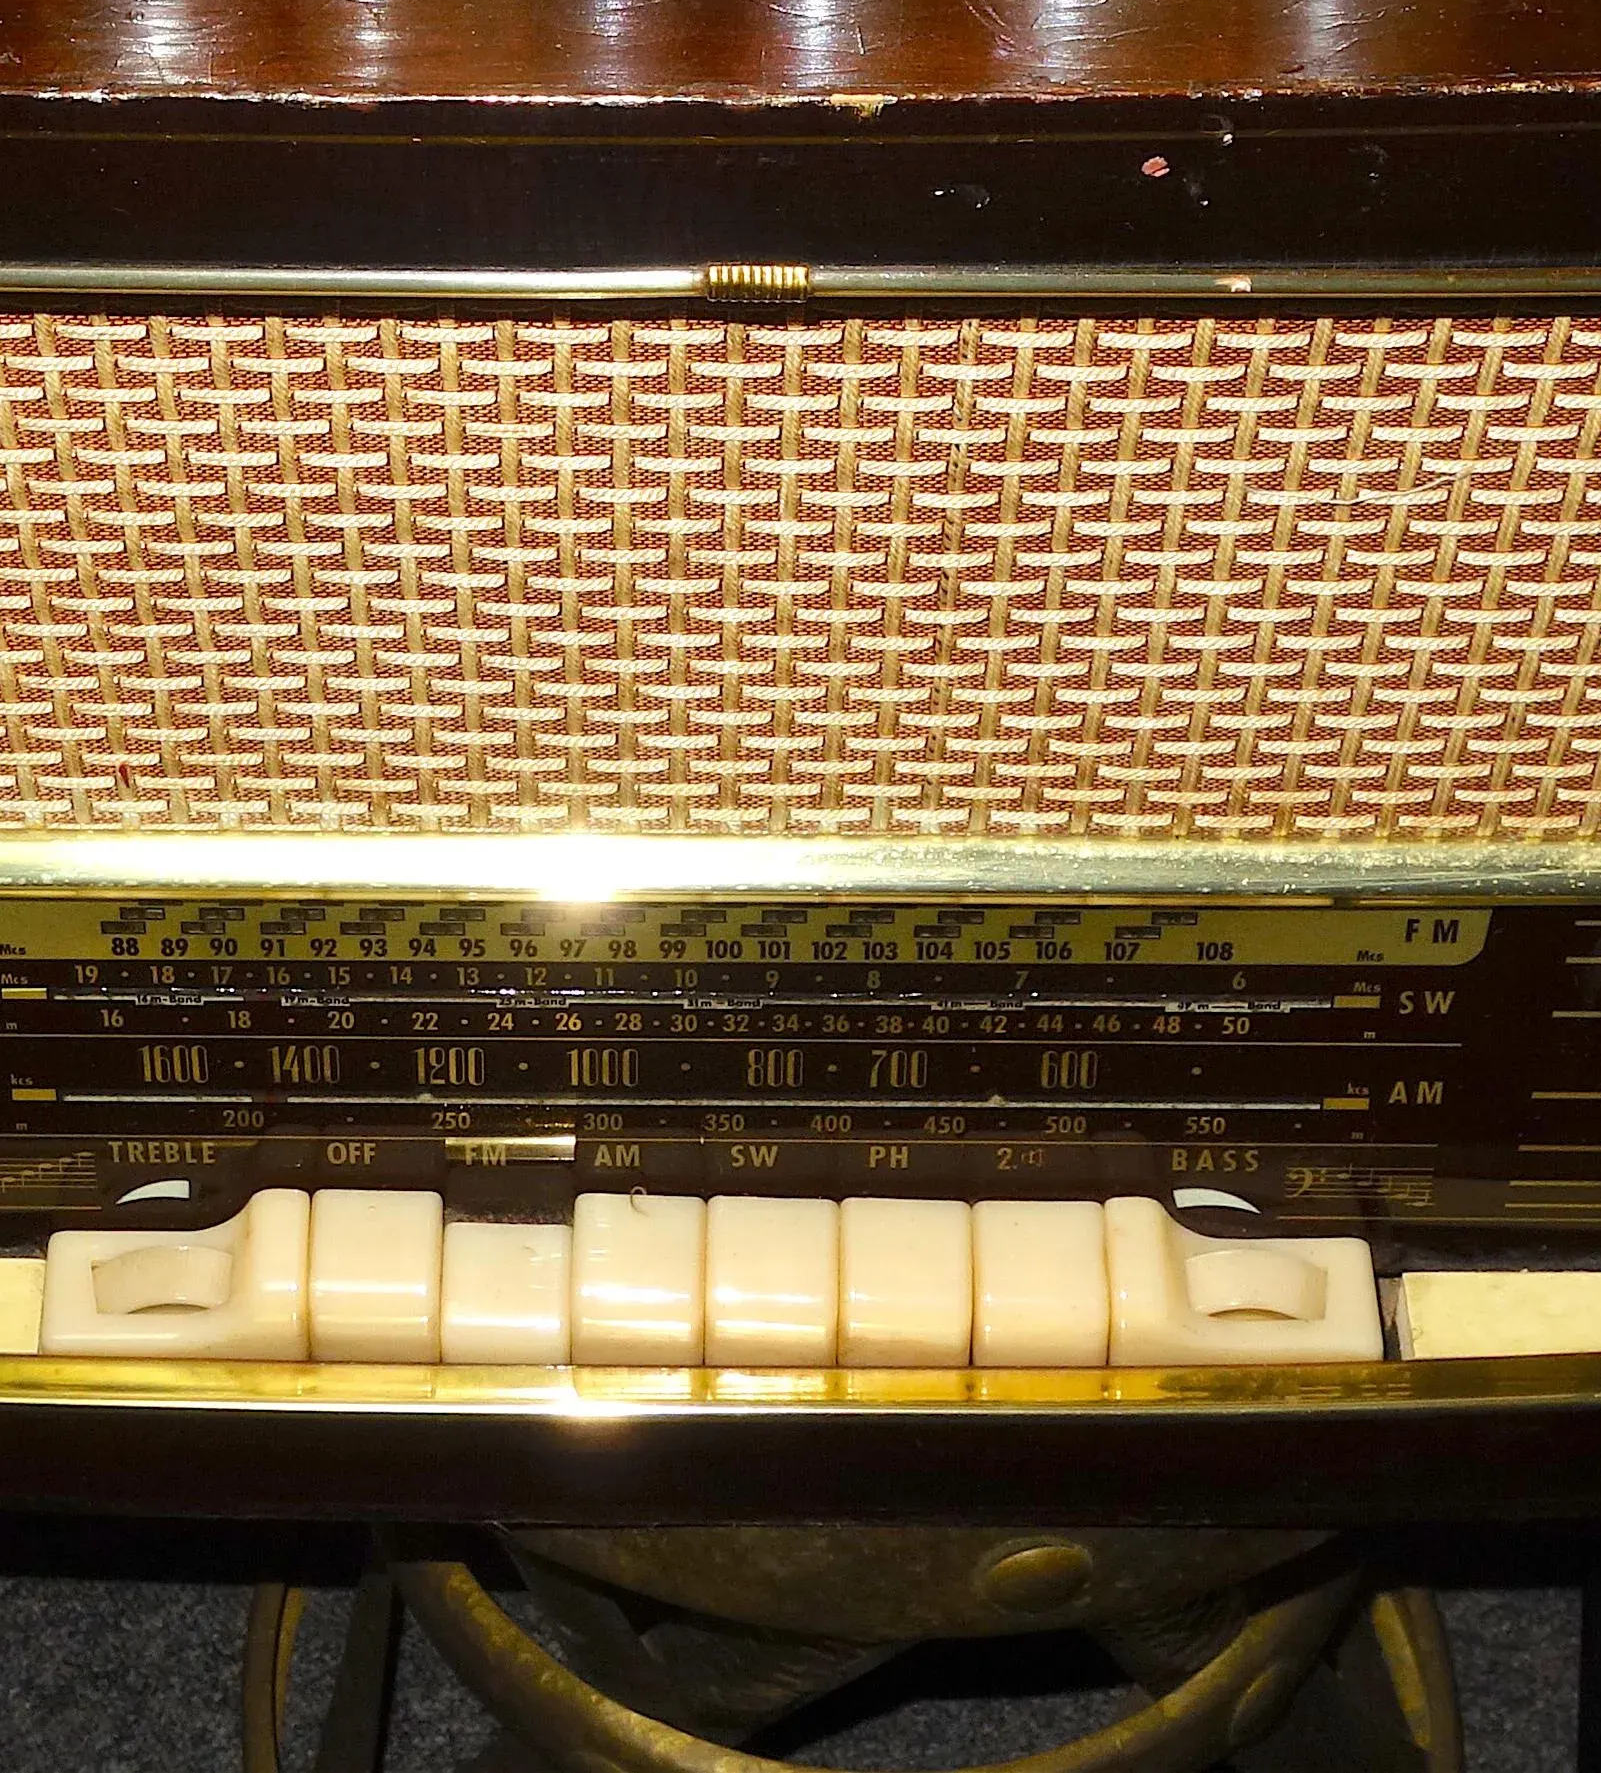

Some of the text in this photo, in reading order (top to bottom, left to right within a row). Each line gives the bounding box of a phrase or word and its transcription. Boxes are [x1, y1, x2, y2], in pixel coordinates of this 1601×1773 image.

[1405, 919, 1460, 943] FM
[111, 938, 1234, 962] 88 89 90 91 92 93 94 95 96 97 98 99 100 101 102 103 104 105 106 107 108
[1399, 991, 1455, 1015] SW
[1387, 1081, 1444, 1104] AM
[109, 1140, 217, 1165] TREBLE
[326, 1141, 377, 1165] OFF
[464, 1144, 507, 1167] FM
[594, 1144, 640, 1167] AM
[730, 1144, 778, 1167] SW
[869, 1145, 909, 1169] PH
[1171, 1148, 1261, 1173] BASS
